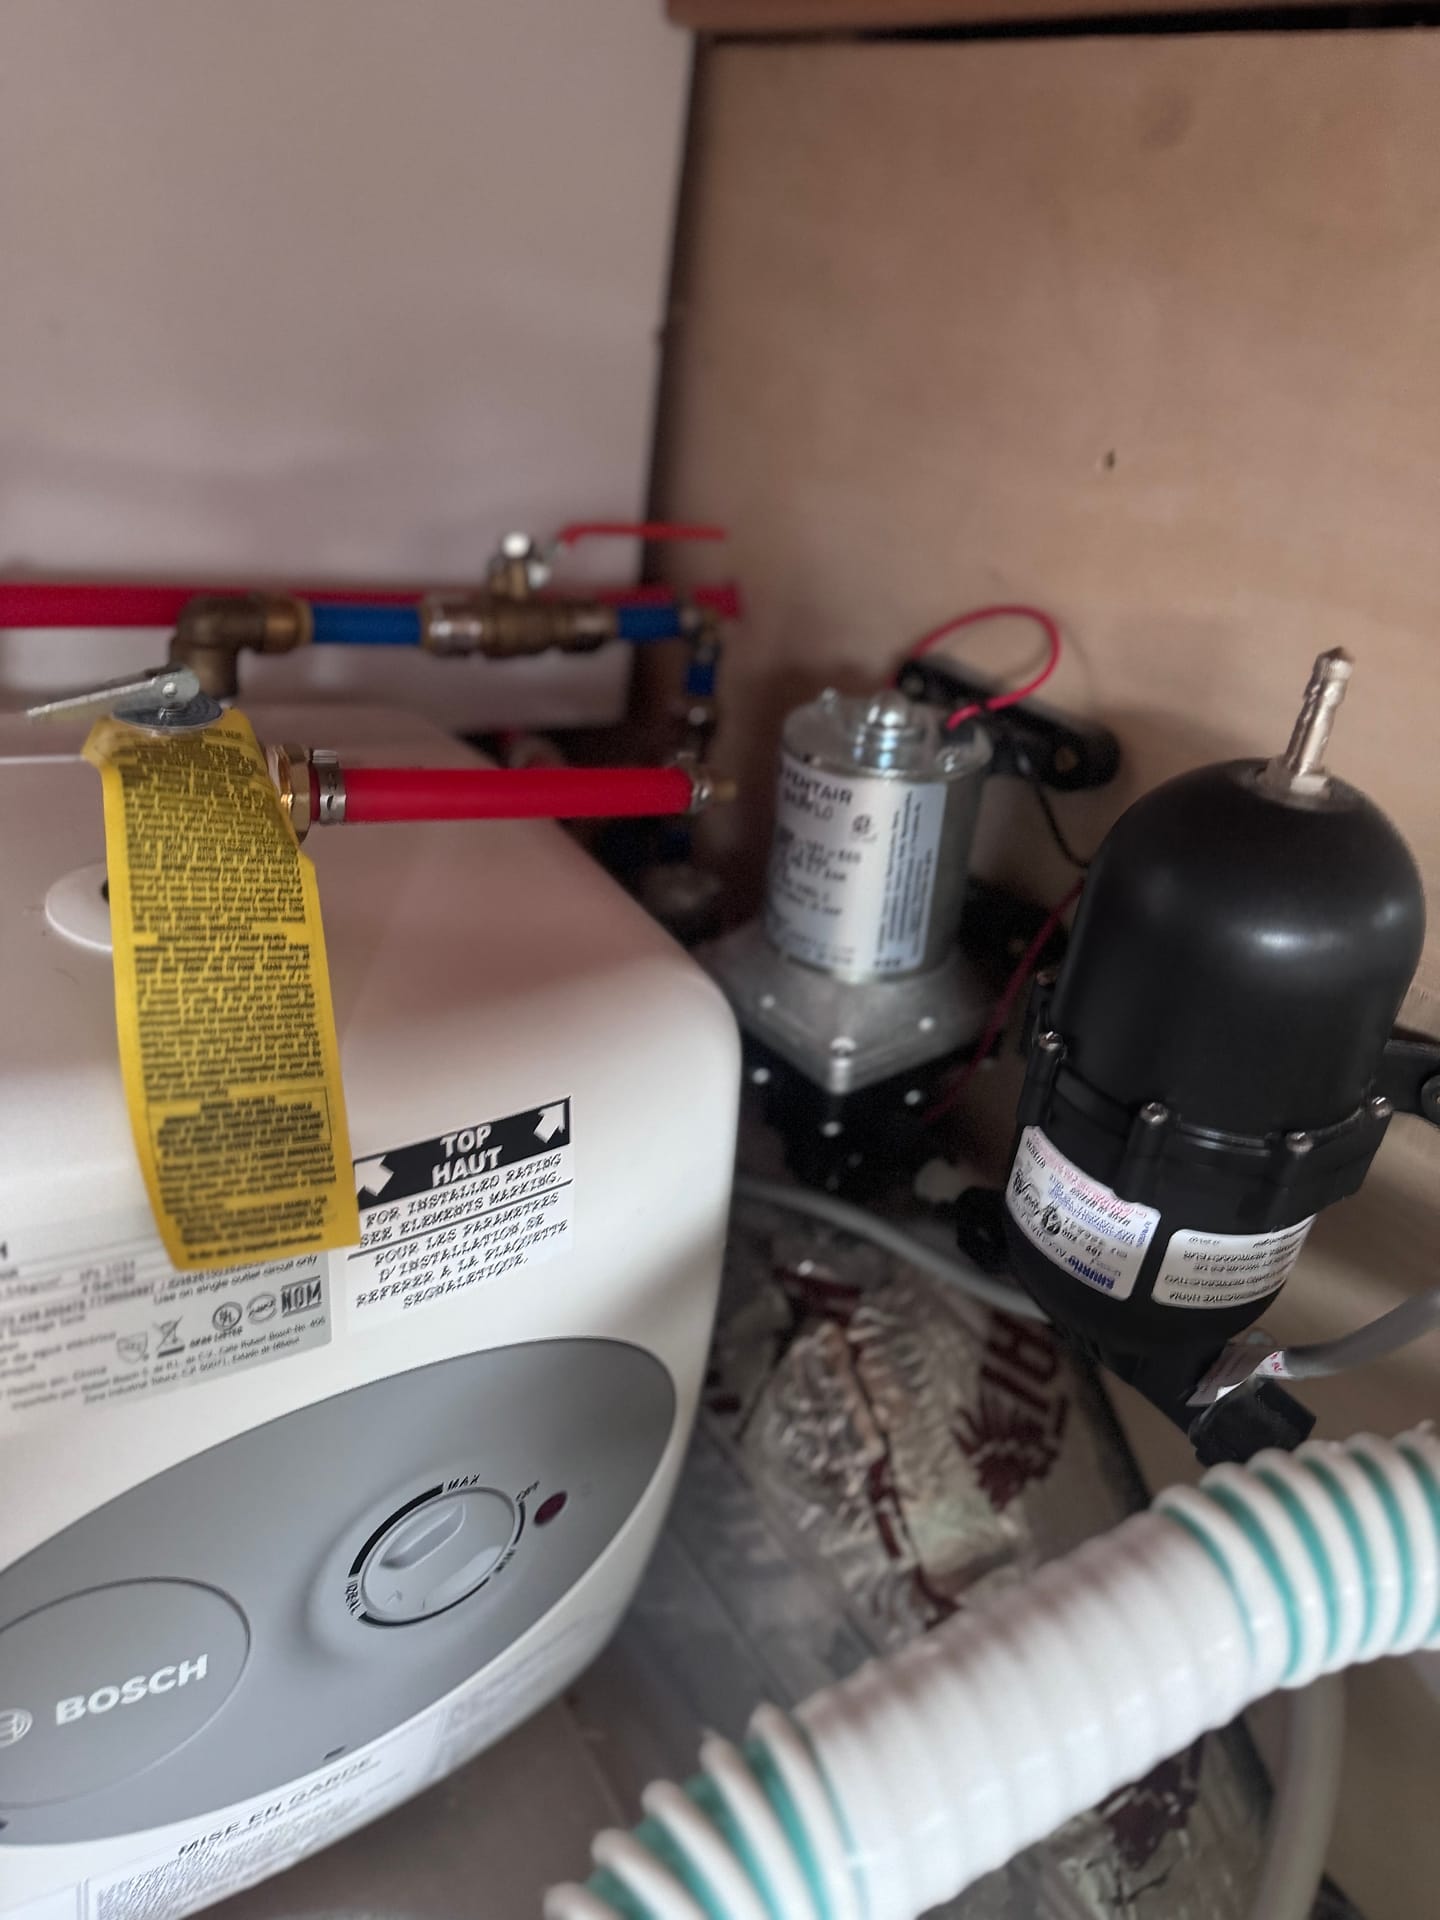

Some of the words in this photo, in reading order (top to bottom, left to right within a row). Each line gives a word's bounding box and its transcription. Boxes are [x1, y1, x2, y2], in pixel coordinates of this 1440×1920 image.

[440, 1124, 493, 1158] TOP
[431, 1145, 503, 1188] HAUT
[366, 1207, 400, 1230] FOR
[407, 1174, 500, 1216] INSTALLED
[360, 1228, 393, 1249] SEE
[55, 1653, 208, 1726] BOSCH
[178, 1820, 242, 1857] MISE
[248, 1802, 282, 1825] EN
